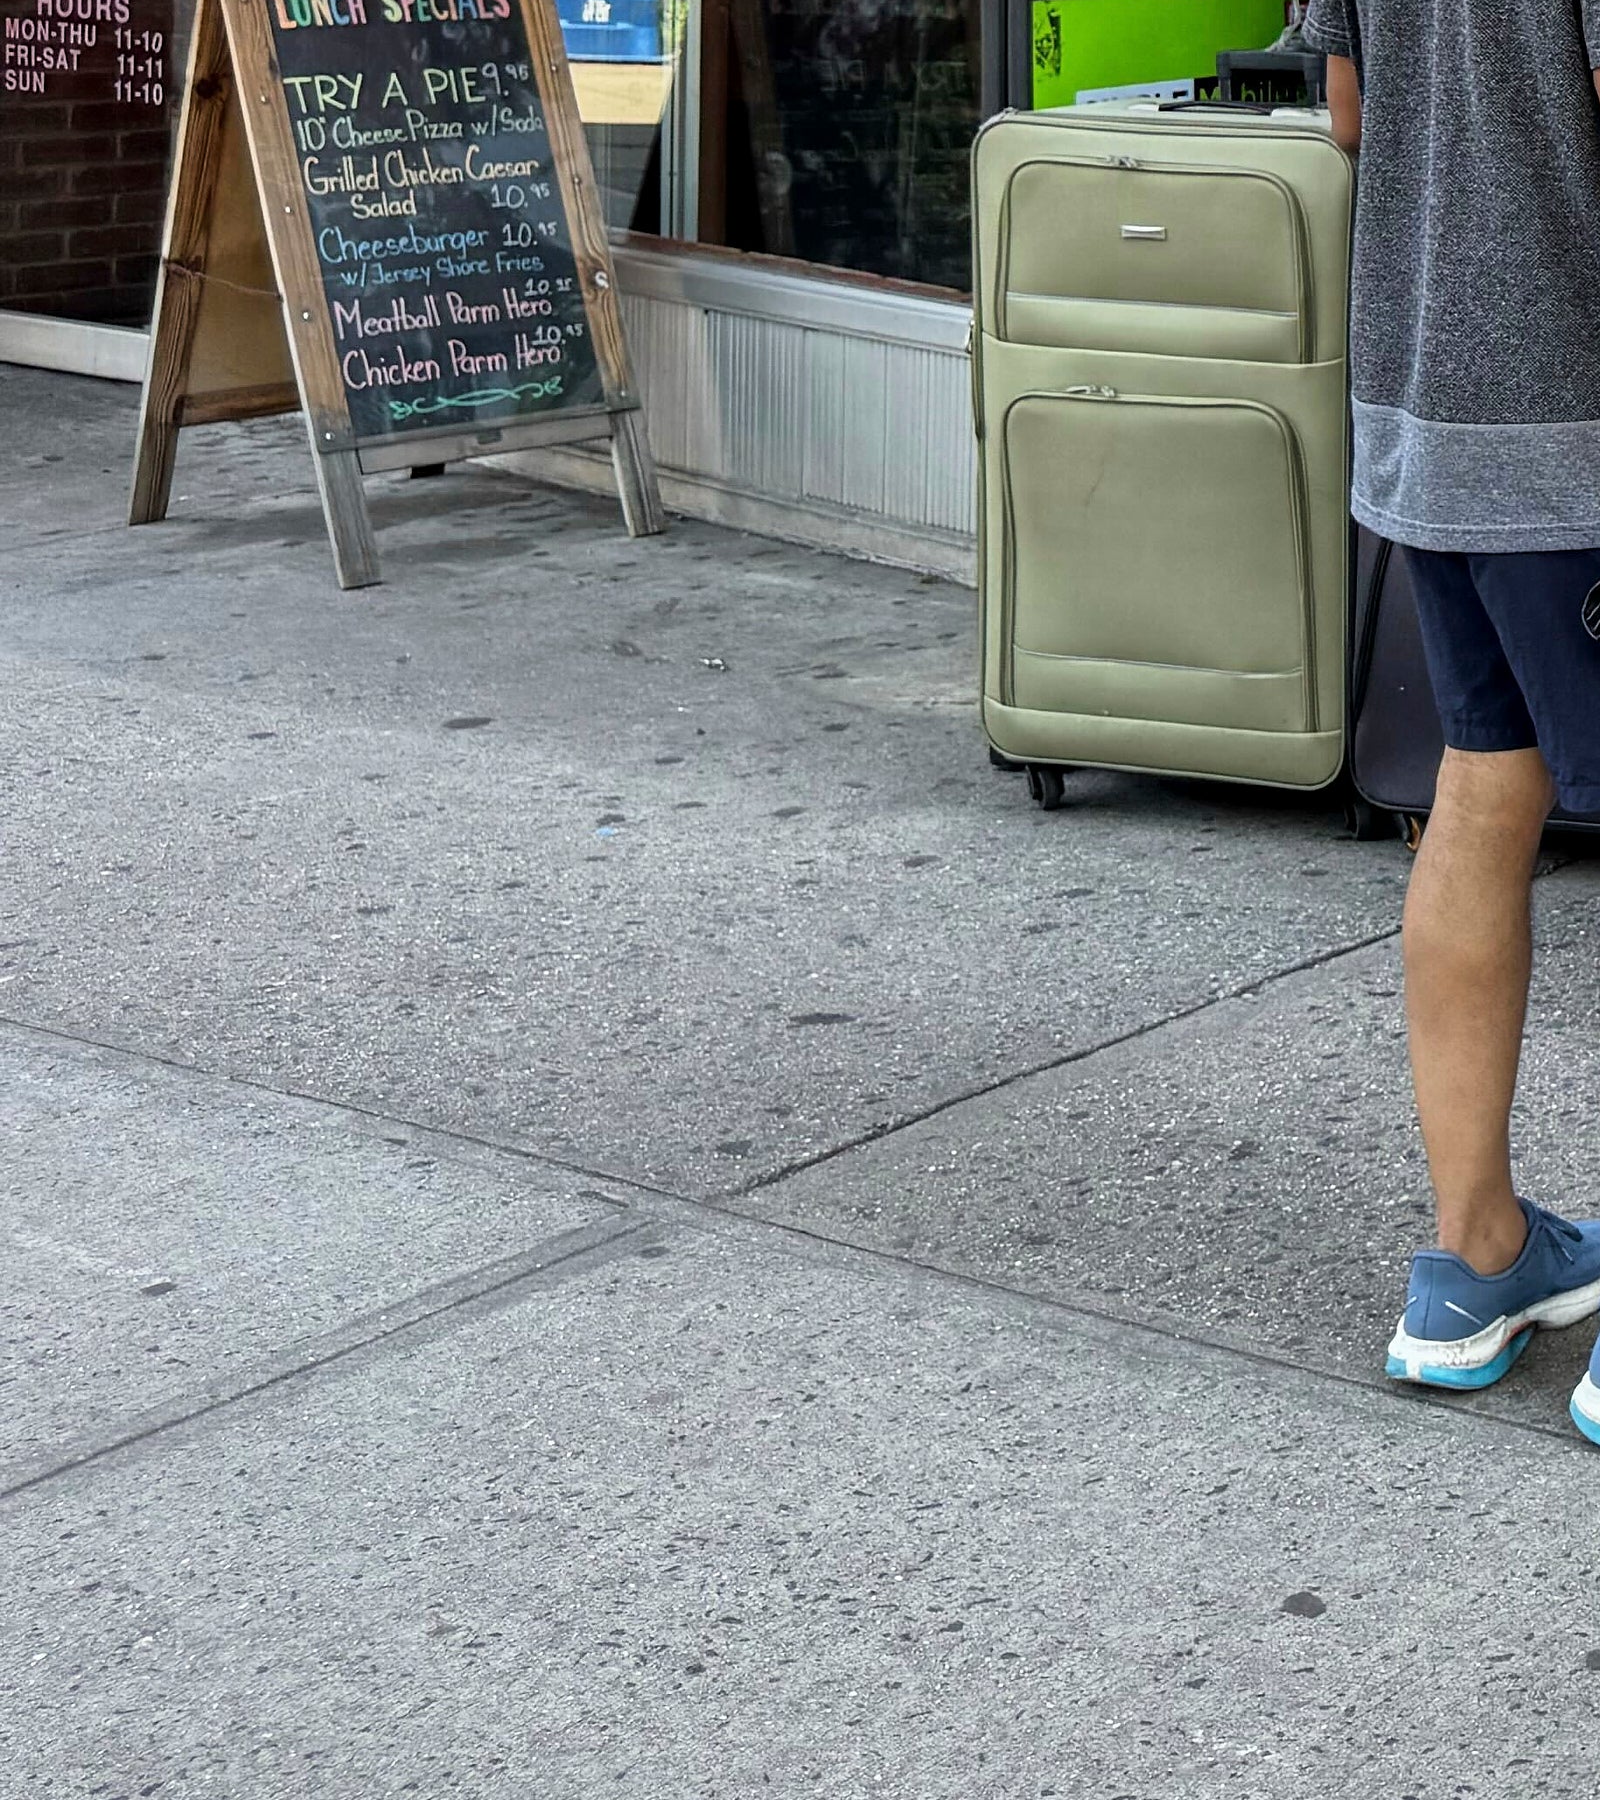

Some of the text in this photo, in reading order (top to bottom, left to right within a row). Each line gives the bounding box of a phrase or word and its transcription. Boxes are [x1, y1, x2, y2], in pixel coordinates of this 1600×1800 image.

[5, 17, 163, 53] MON-THU 11-10
[5, 43, 163, 79] FRI-SAT 11-11
[5, 68, 163, 106] SUN 11-10
[282, 67, 486, 114] TRY A PIE
[332, 108, 464, 150] Cheese Pizza
[303, 144, 540, 196] Grilled Chicken Caesar
[350, 189, 416, 220] Salad
[318, 225, 489, 265] Cheeseburger
[332, 286, 553, 341] Meatball Parm Hero
[343, 332, 563, 390] Chicken Parm Hero
